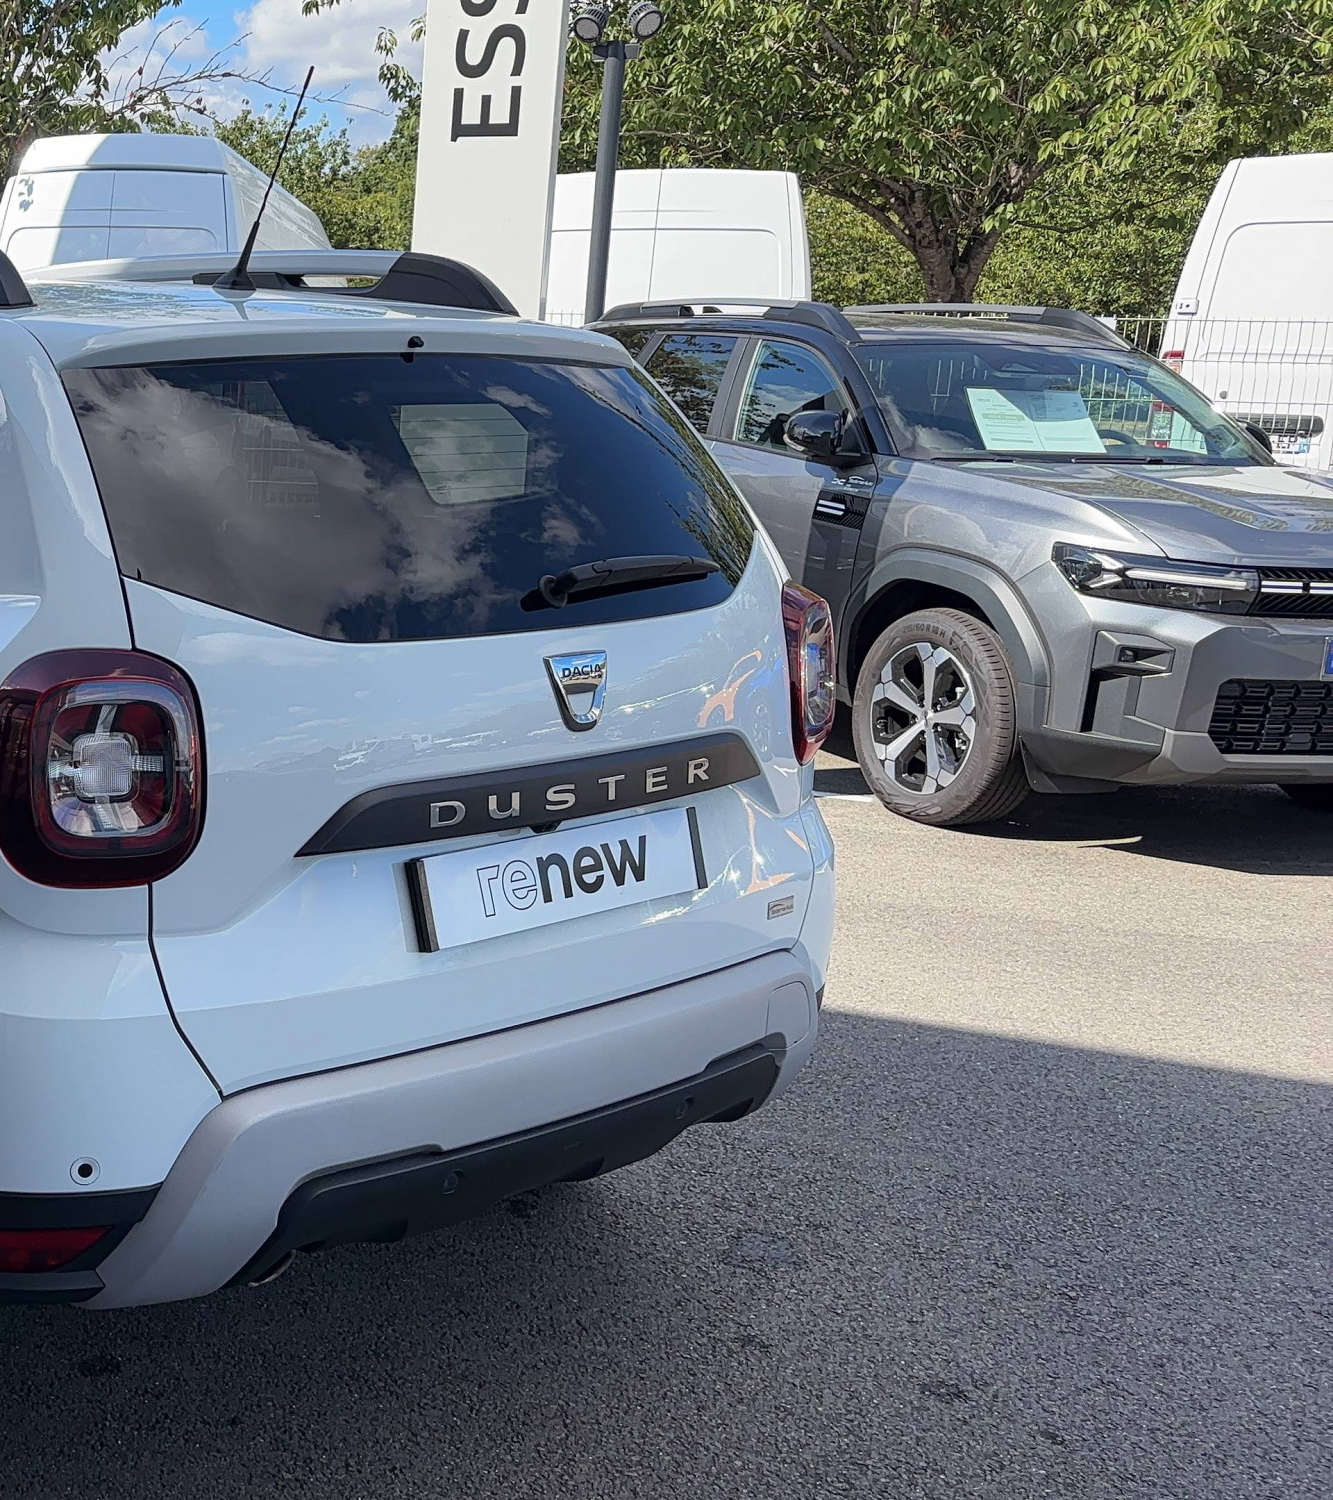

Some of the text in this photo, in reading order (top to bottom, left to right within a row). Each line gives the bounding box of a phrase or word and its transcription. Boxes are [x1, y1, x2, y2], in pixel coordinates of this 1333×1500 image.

[561, 663, 602, 678] DACIA
[429, 757, 710, 829] DUSTER
[476, 834, 647, 918] renew
